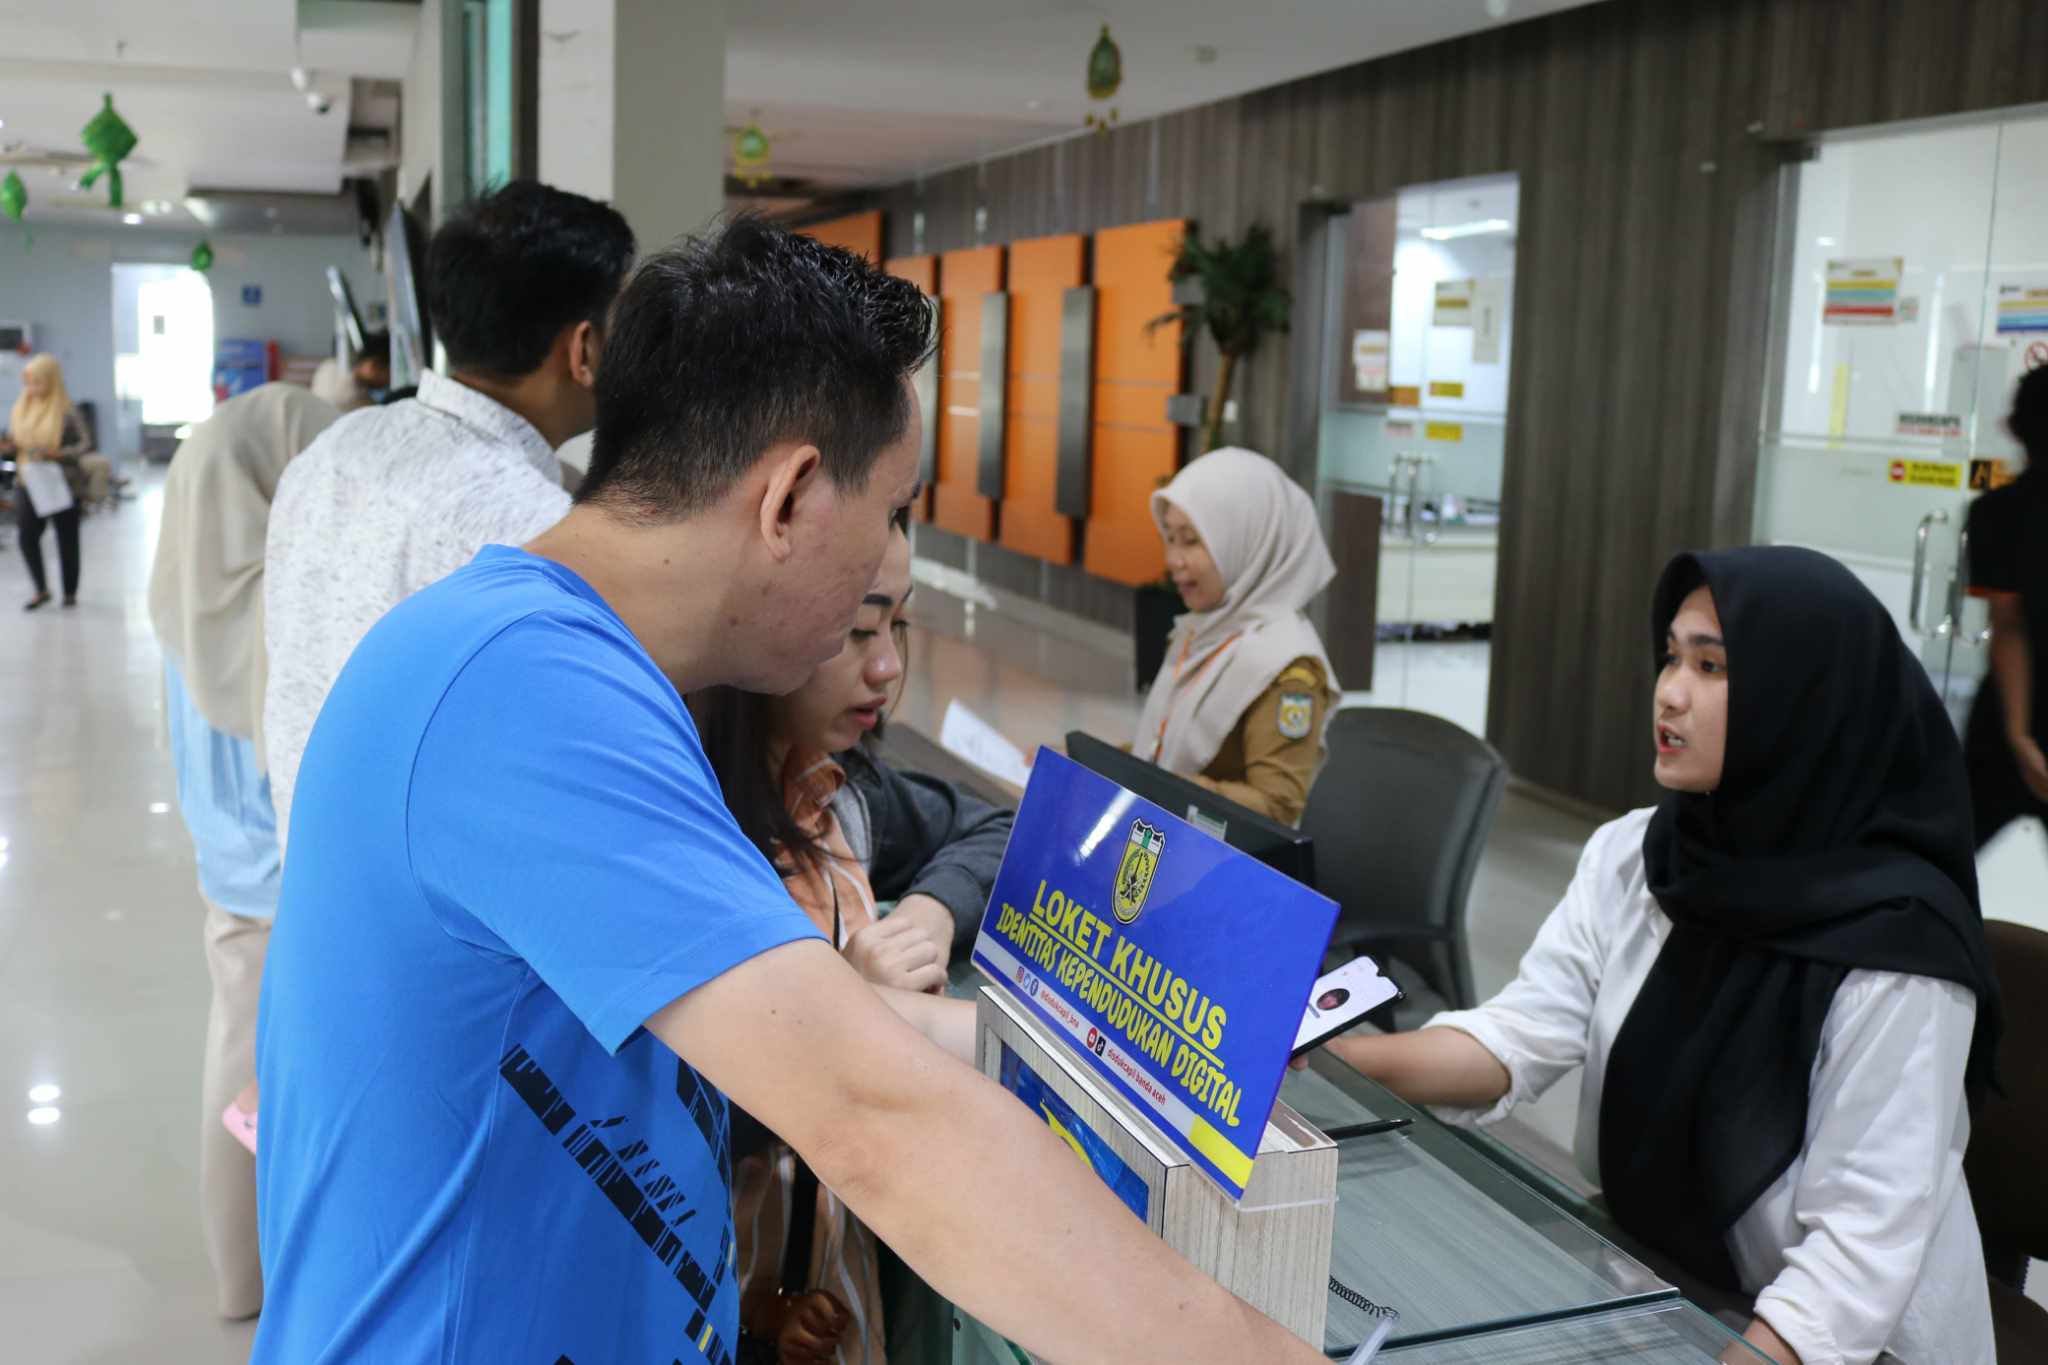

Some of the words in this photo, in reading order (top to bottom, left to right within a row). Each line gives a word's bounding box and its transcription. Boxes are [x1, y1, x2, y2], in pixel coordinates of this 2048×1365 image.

[996, 903, 1061, 972] IDENTITAS
[1056, 950, 1176, 1068] KEPENDUDUKAN
[1171, 1044, 1242, 1127] DIGITAL
[1032, 880, 1112, 958] LOKET
[1110, 936, 1227, 1050] KHUSUS
[1135, 1073, 1153, 1093] banda
[1152, 1088, 1166, 1105] aceh
